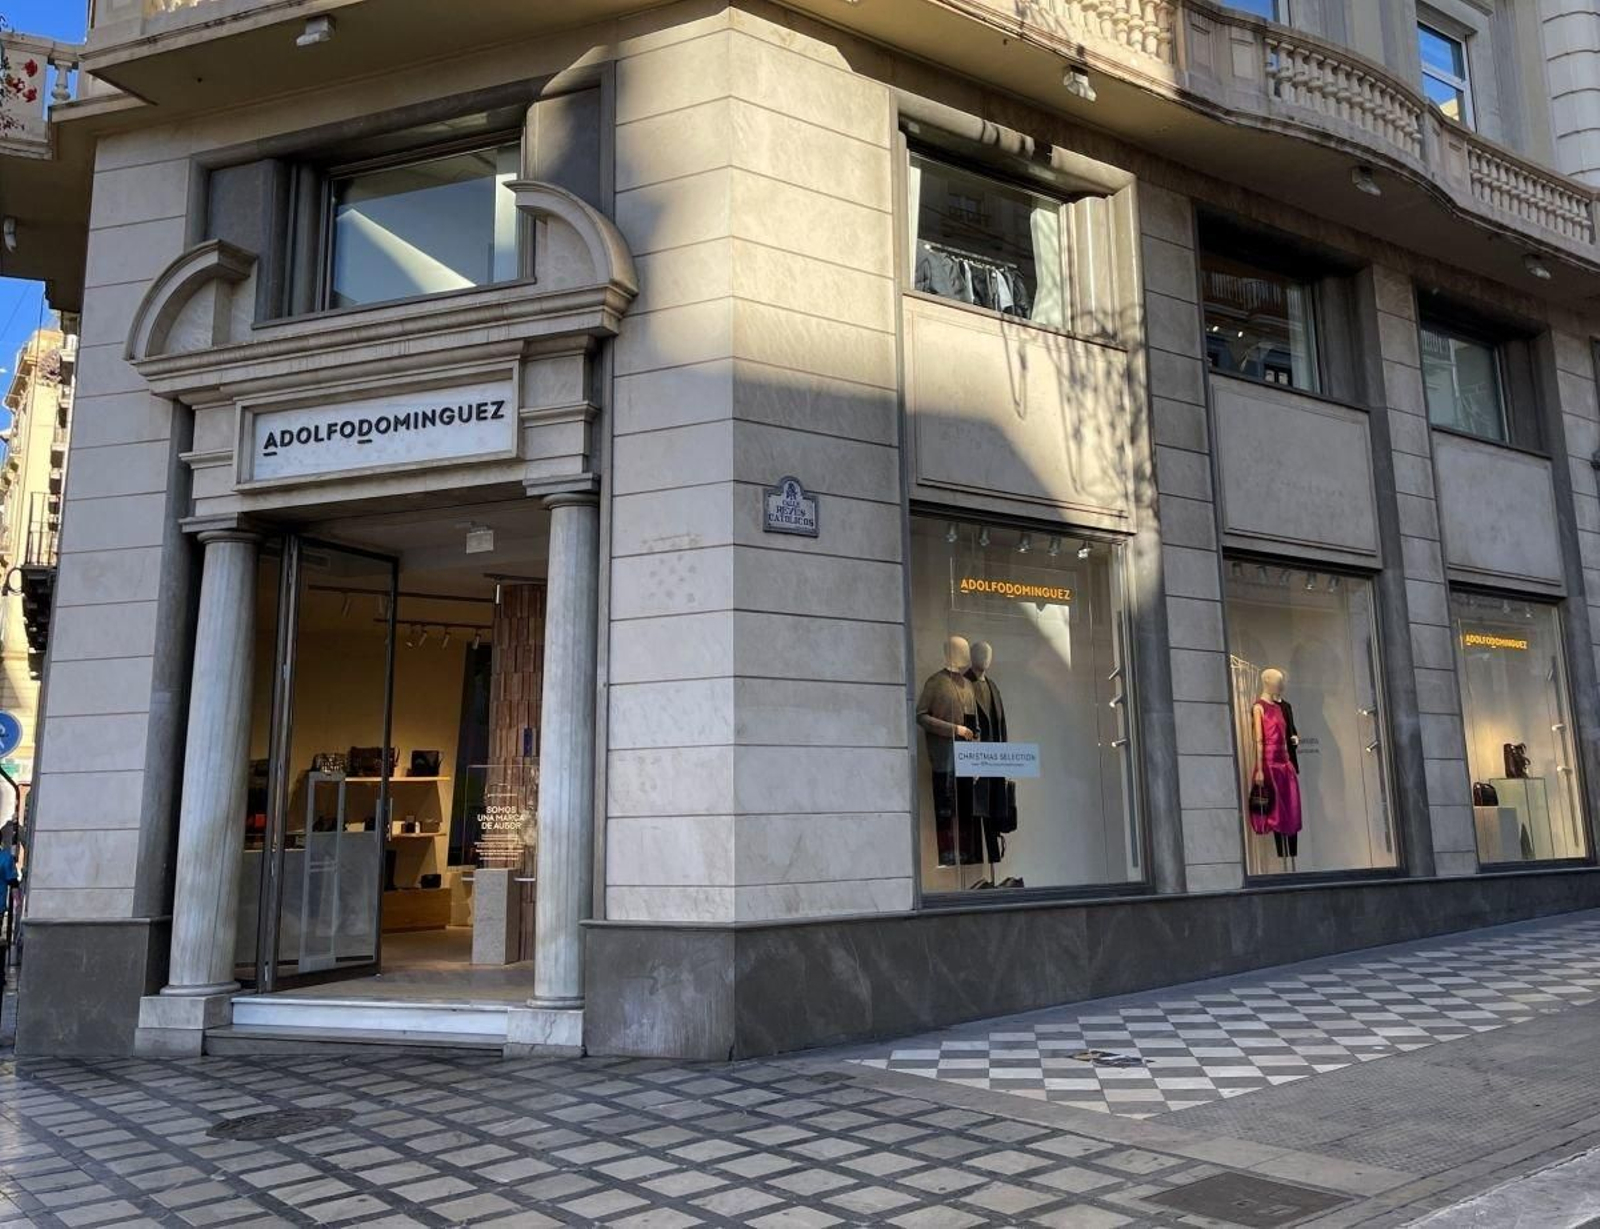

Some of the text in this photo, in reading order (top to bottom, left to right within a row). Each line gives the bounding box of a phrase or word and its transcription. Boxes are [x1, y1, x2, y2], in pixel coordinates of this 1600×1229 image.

[263, 400, 506, 457] ADOLFODOMINGUEZ
[960, 579, 1071, 600] ADOLFODOMINGUEZ
[958, 752, 1036, 762] CHRISTMAS SELECTION
[486, 805, 517, 814] SOMOS
[476, 813, 525, 822] UNA MARCA
[481, 821, 493, 830] DE
